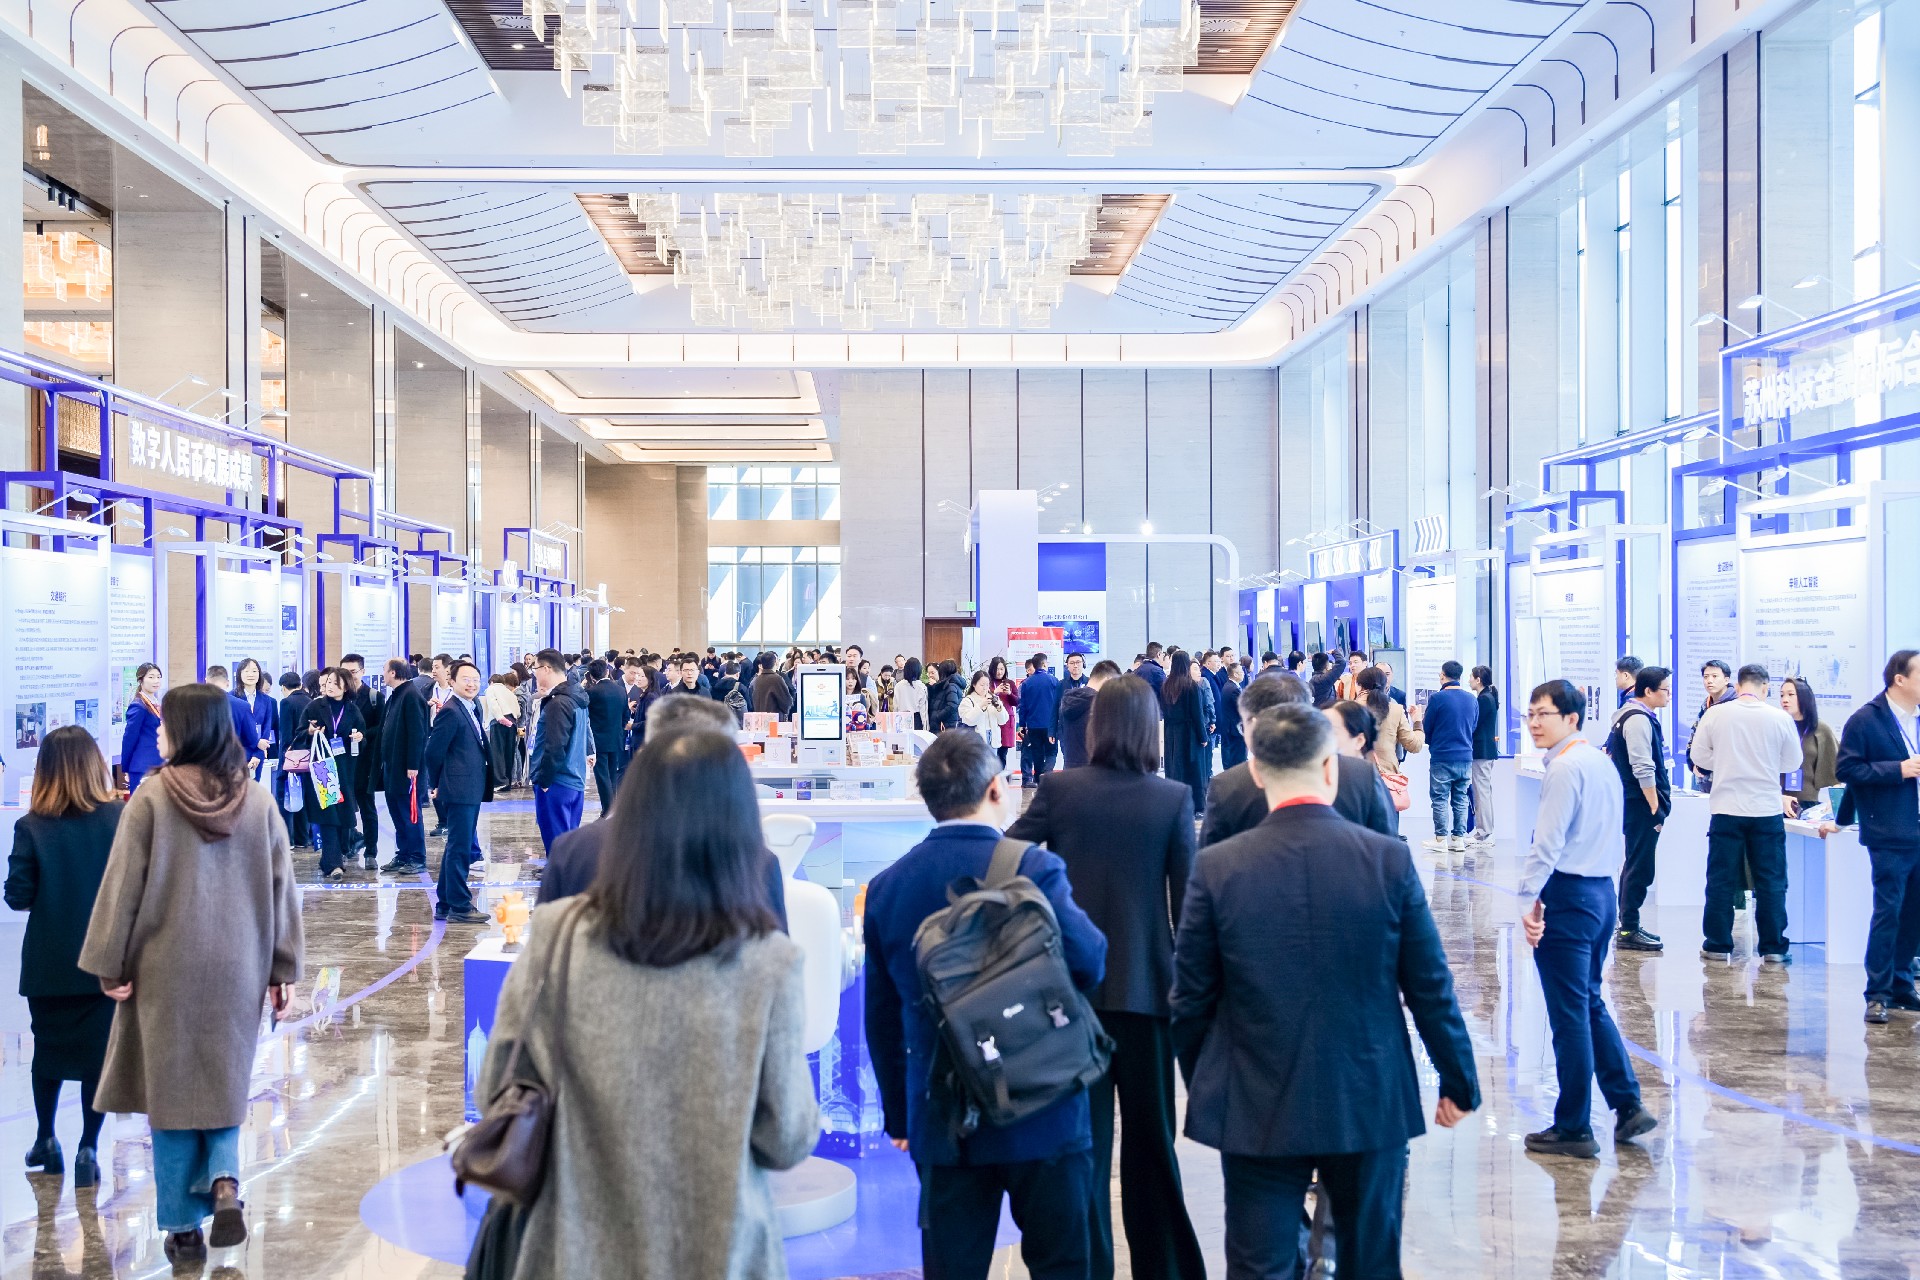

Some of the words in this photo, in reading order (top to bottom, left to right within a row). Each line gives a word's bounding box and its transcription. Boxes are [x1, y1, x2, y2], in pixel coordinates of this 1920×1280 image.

[130, 420, 253, 492] 数字人民币发展成果
